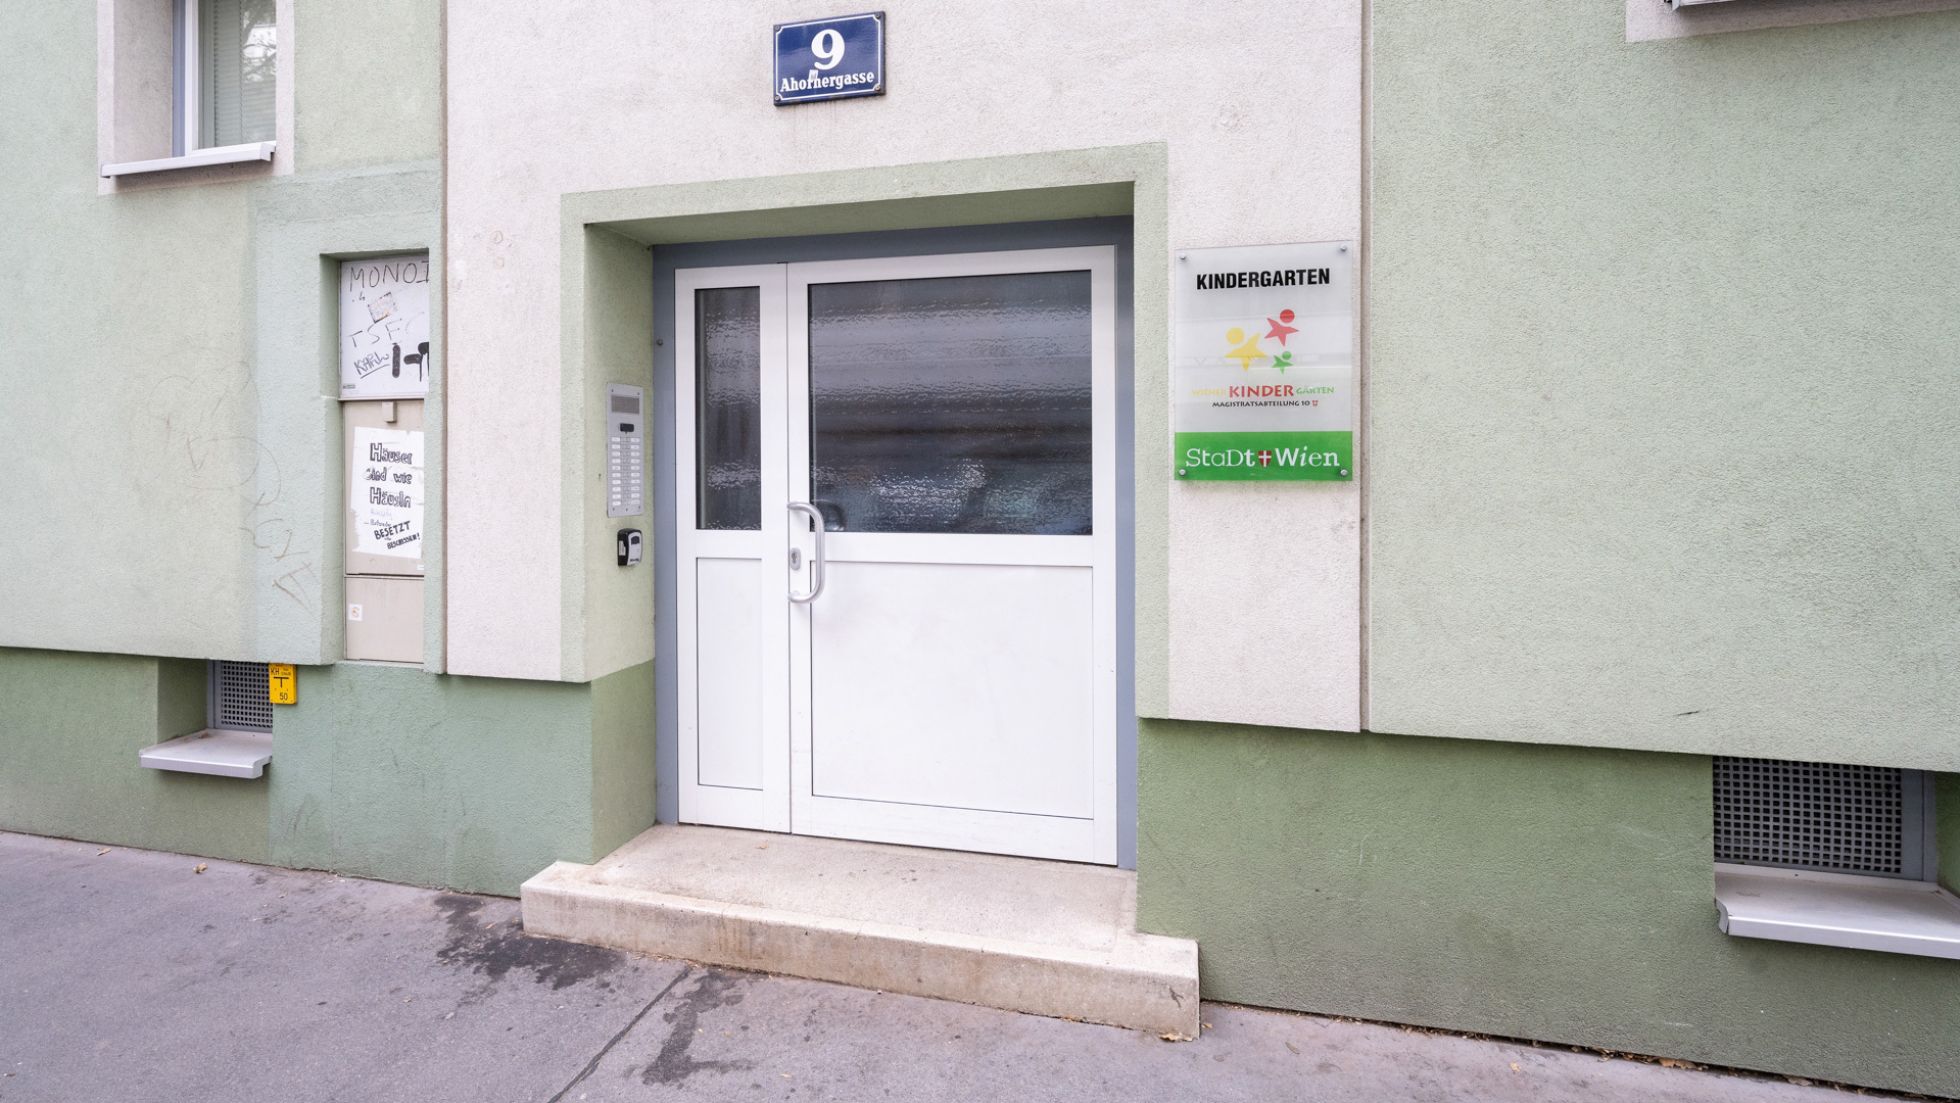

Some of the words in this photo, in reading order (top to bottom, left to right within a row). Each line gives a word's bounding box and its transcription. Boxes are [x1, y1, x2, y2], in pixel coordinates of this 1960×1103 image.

[811, 29, 845, 70] 9
[780, 72, 875, 92] Ahornergasse
[1197, 268, 1330, 290] KINDERGARTEN
[1229, 385, 1294, 398] KINDER
[1212, 400, 1300, 408] MAGISTRATSABTEILUNG
[1275, 446, 1340, 467] Wien
[374, 520, 411, 541] BESETZT
[279, 692, 288, 701] 50
